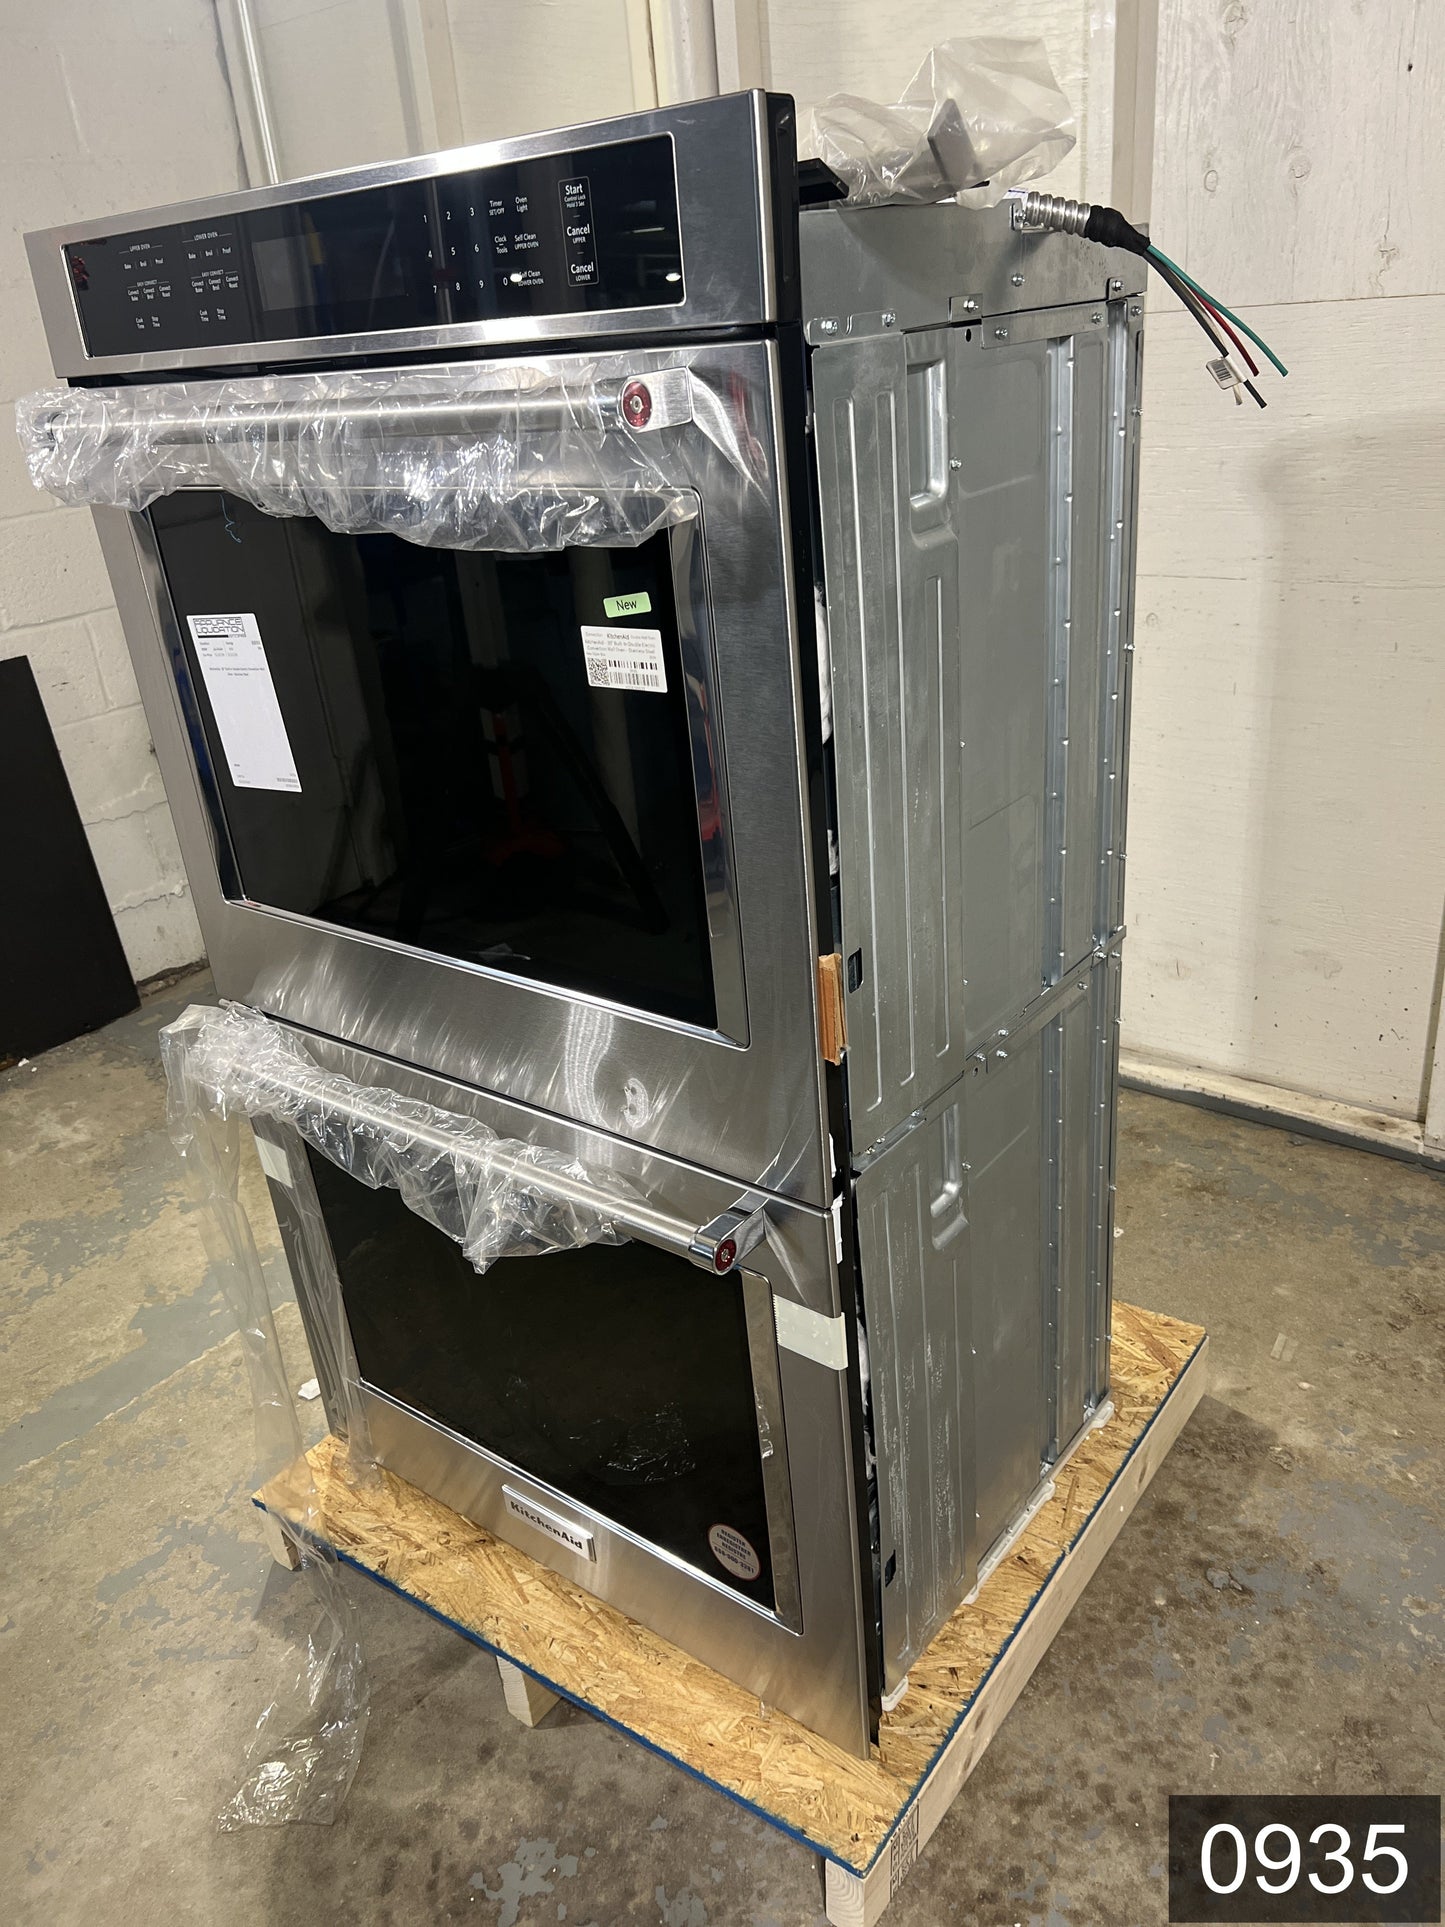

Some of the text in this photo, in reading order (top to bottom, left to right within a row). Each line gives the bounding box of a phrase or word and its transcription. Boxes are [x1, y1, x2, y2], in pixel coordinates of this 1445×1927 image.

[565, 184, 583, 195] Start
[424, 207, 474, 223] 1 2 3
[567, 224, 590, 236] Cancel
[573, 236, 586, 244] UPPER
[428, 244, 479, 258] 4 5 6
[571, 262, 594, 273] Cancel
[456, 282, 460, 290] 8
[479, 280, 483, 288] 9
[503, 277, 508, 285] 0
[576, 274, 590, 282] LOWER
[616, 600, 637, 611] New
[194, 618, 241, 626] APPLIANCE
[196, 626, 245, 634] LIQUIDATION
[511, 1501, 582, 1549] KitchenAid
